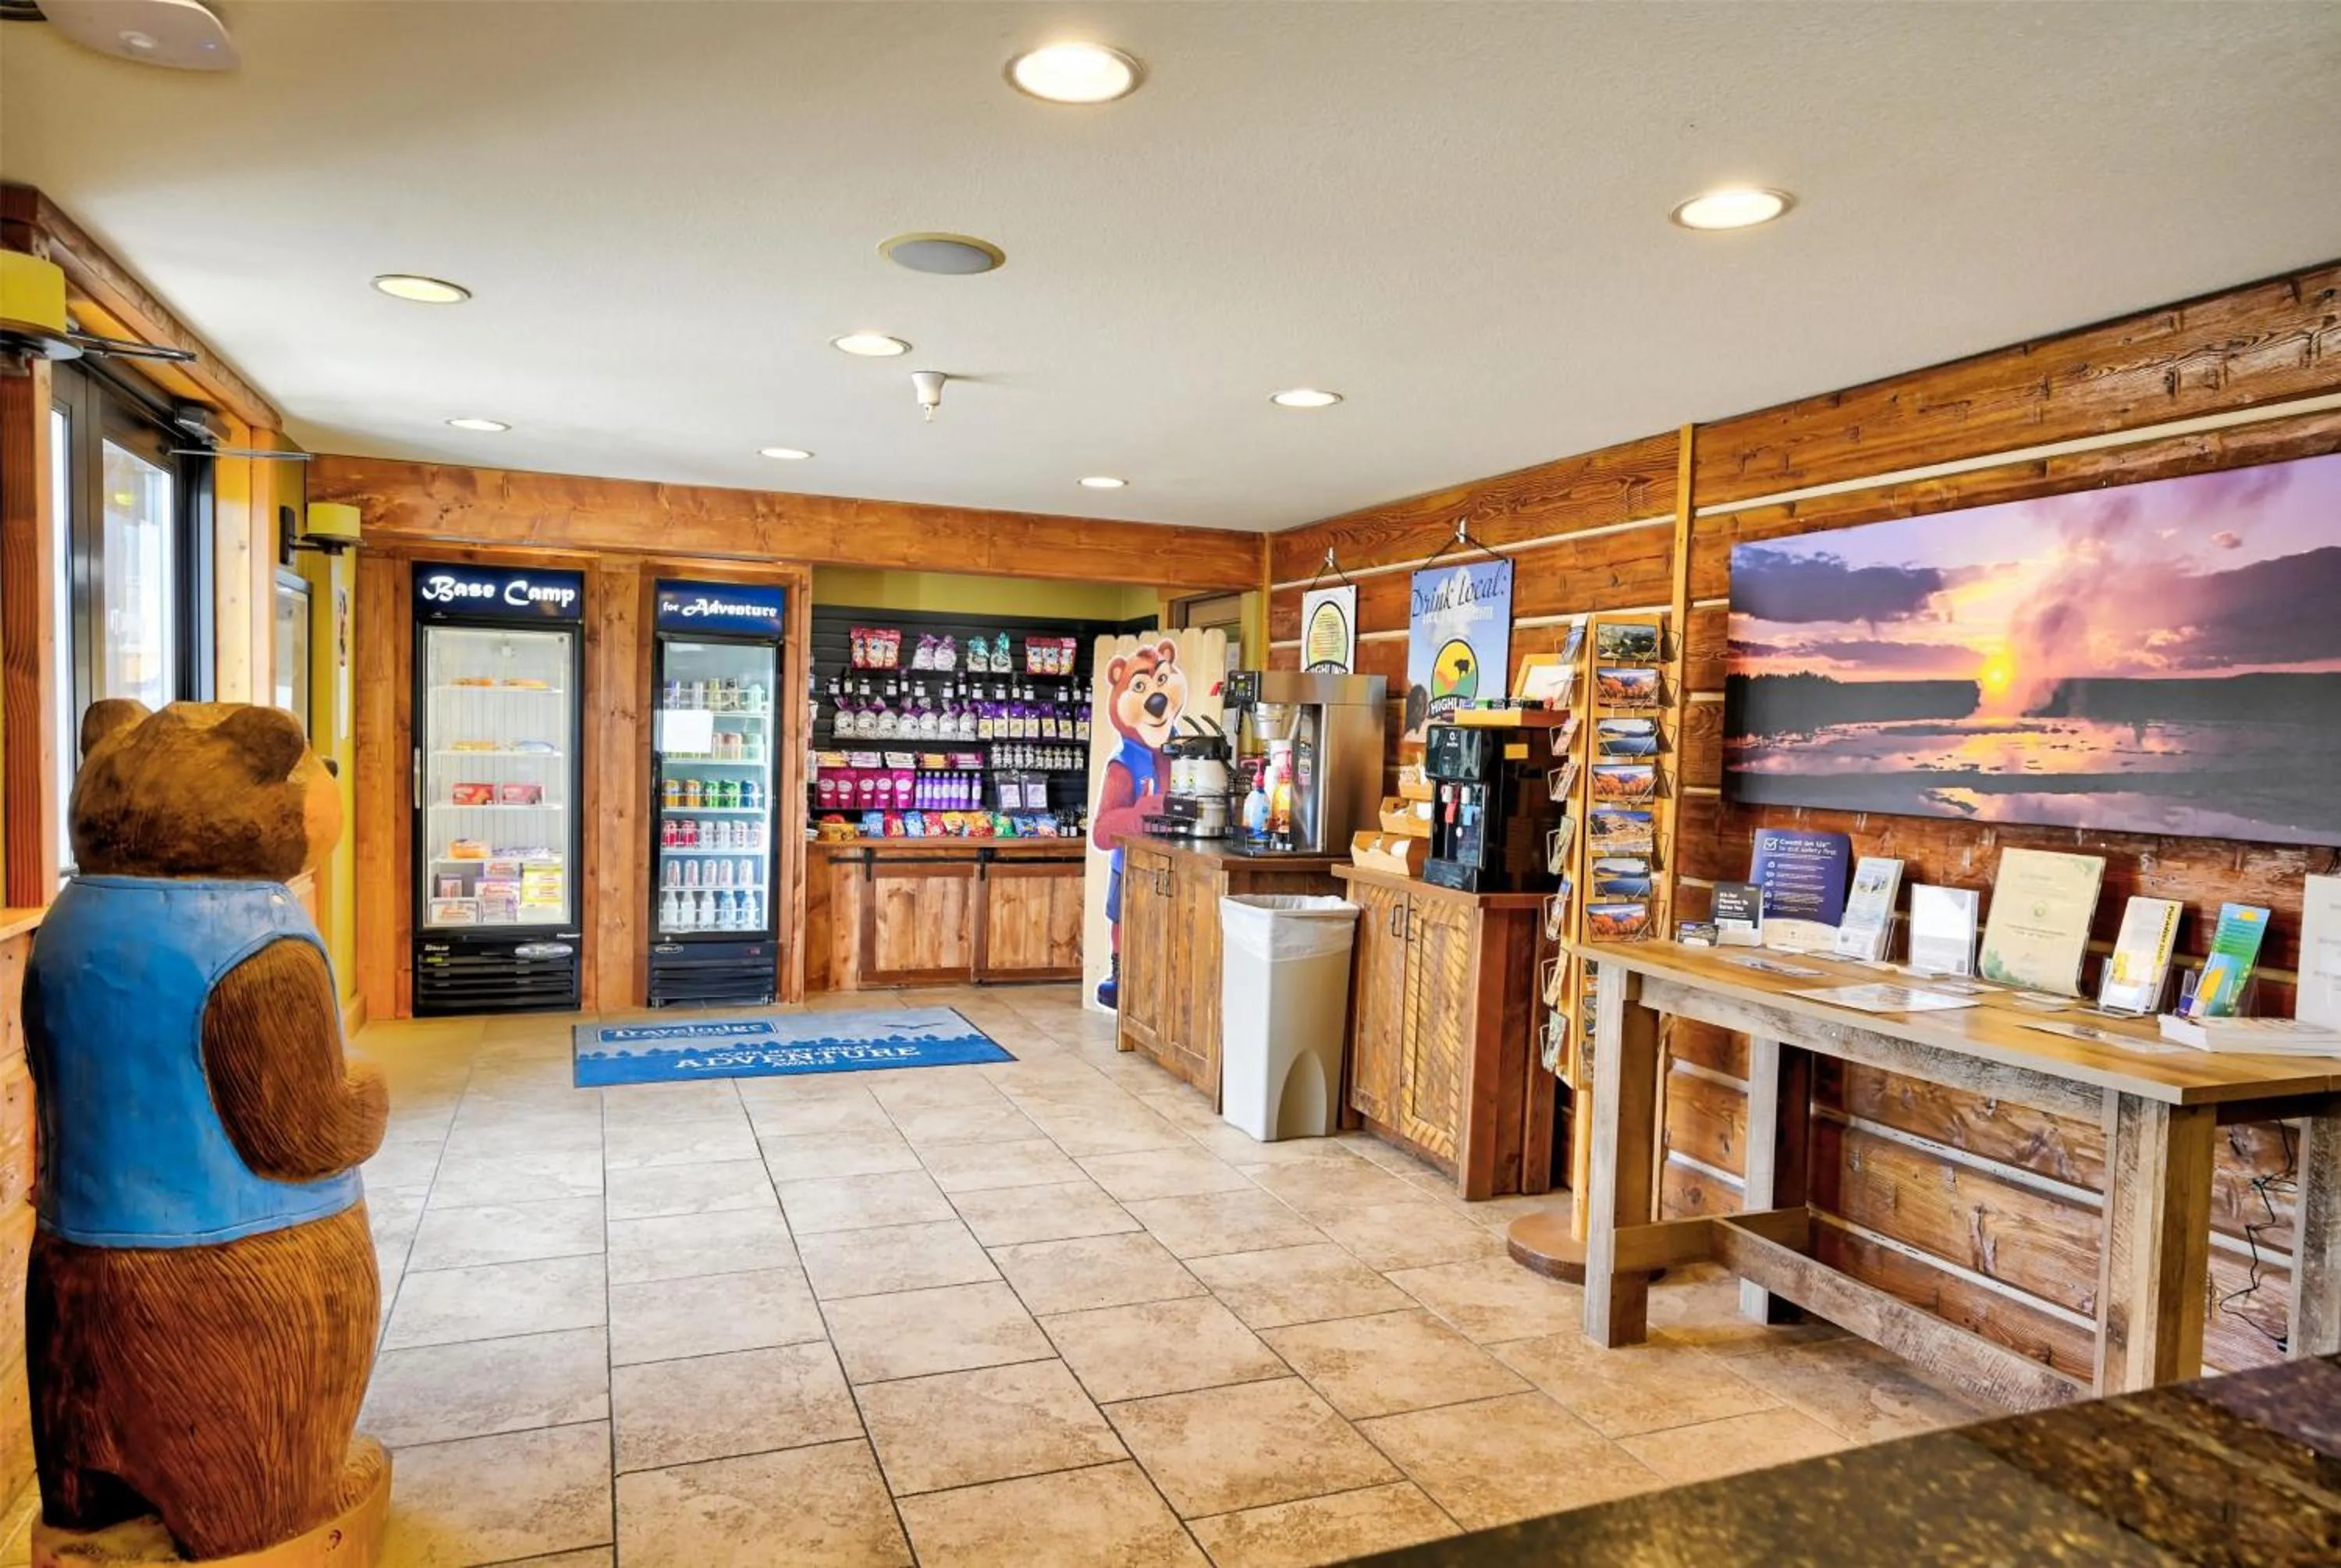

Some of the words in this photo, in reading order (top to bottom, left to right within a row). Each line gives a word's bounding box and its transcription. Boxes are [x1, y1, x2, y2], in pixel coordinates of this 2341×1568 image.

[422, 576, 495, 601] Base
[503, 580, 576, 608] Camp
[663, 600, 680, 612] for
[681, 598, 778, 618] Adventure
[673, 1045, 922, 1069] ADVENTURE
